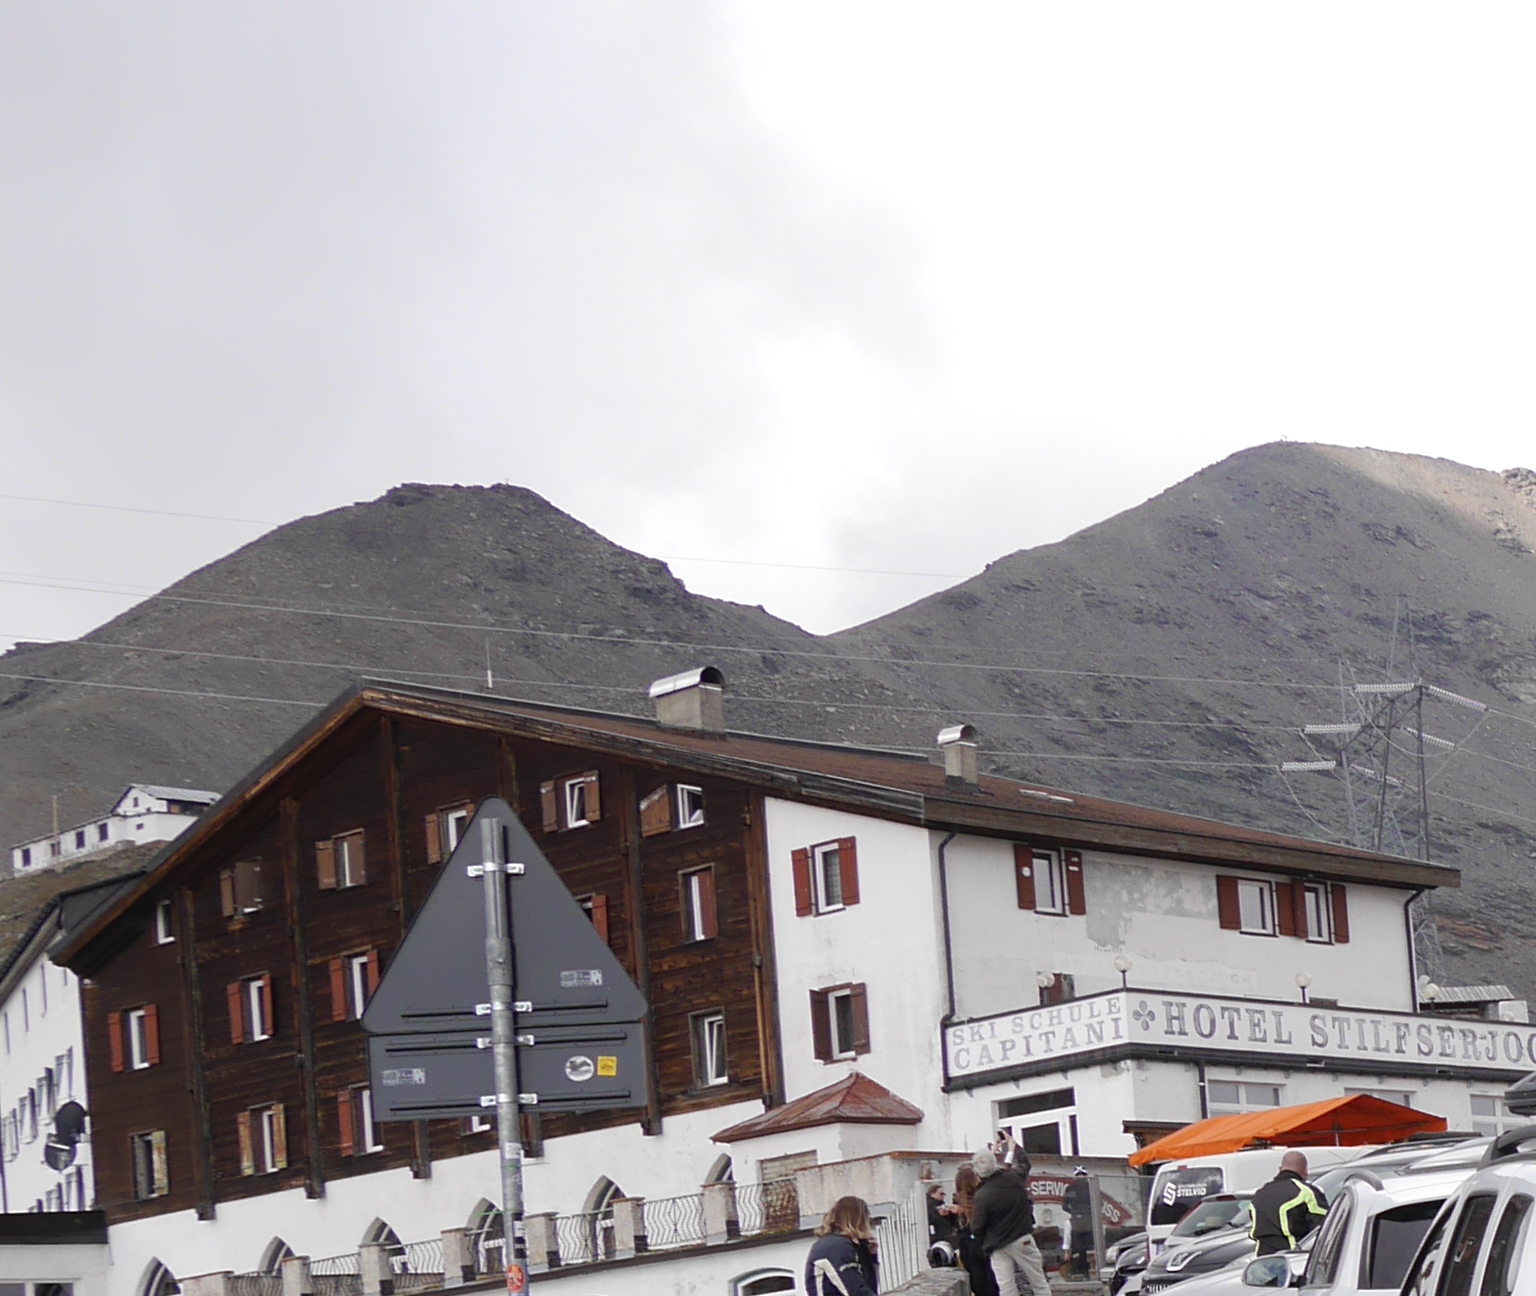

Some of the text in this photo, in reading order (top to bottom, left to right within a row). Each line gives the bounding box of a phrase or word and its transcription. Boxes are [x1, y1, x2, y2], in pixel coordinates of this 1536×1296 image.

[952, 996, 1122, 1046] SKI SCHULE
[954, 1017, 1124, 1070] CAPITANI
[1161, 1000, 1293, 1046] HOTEL
